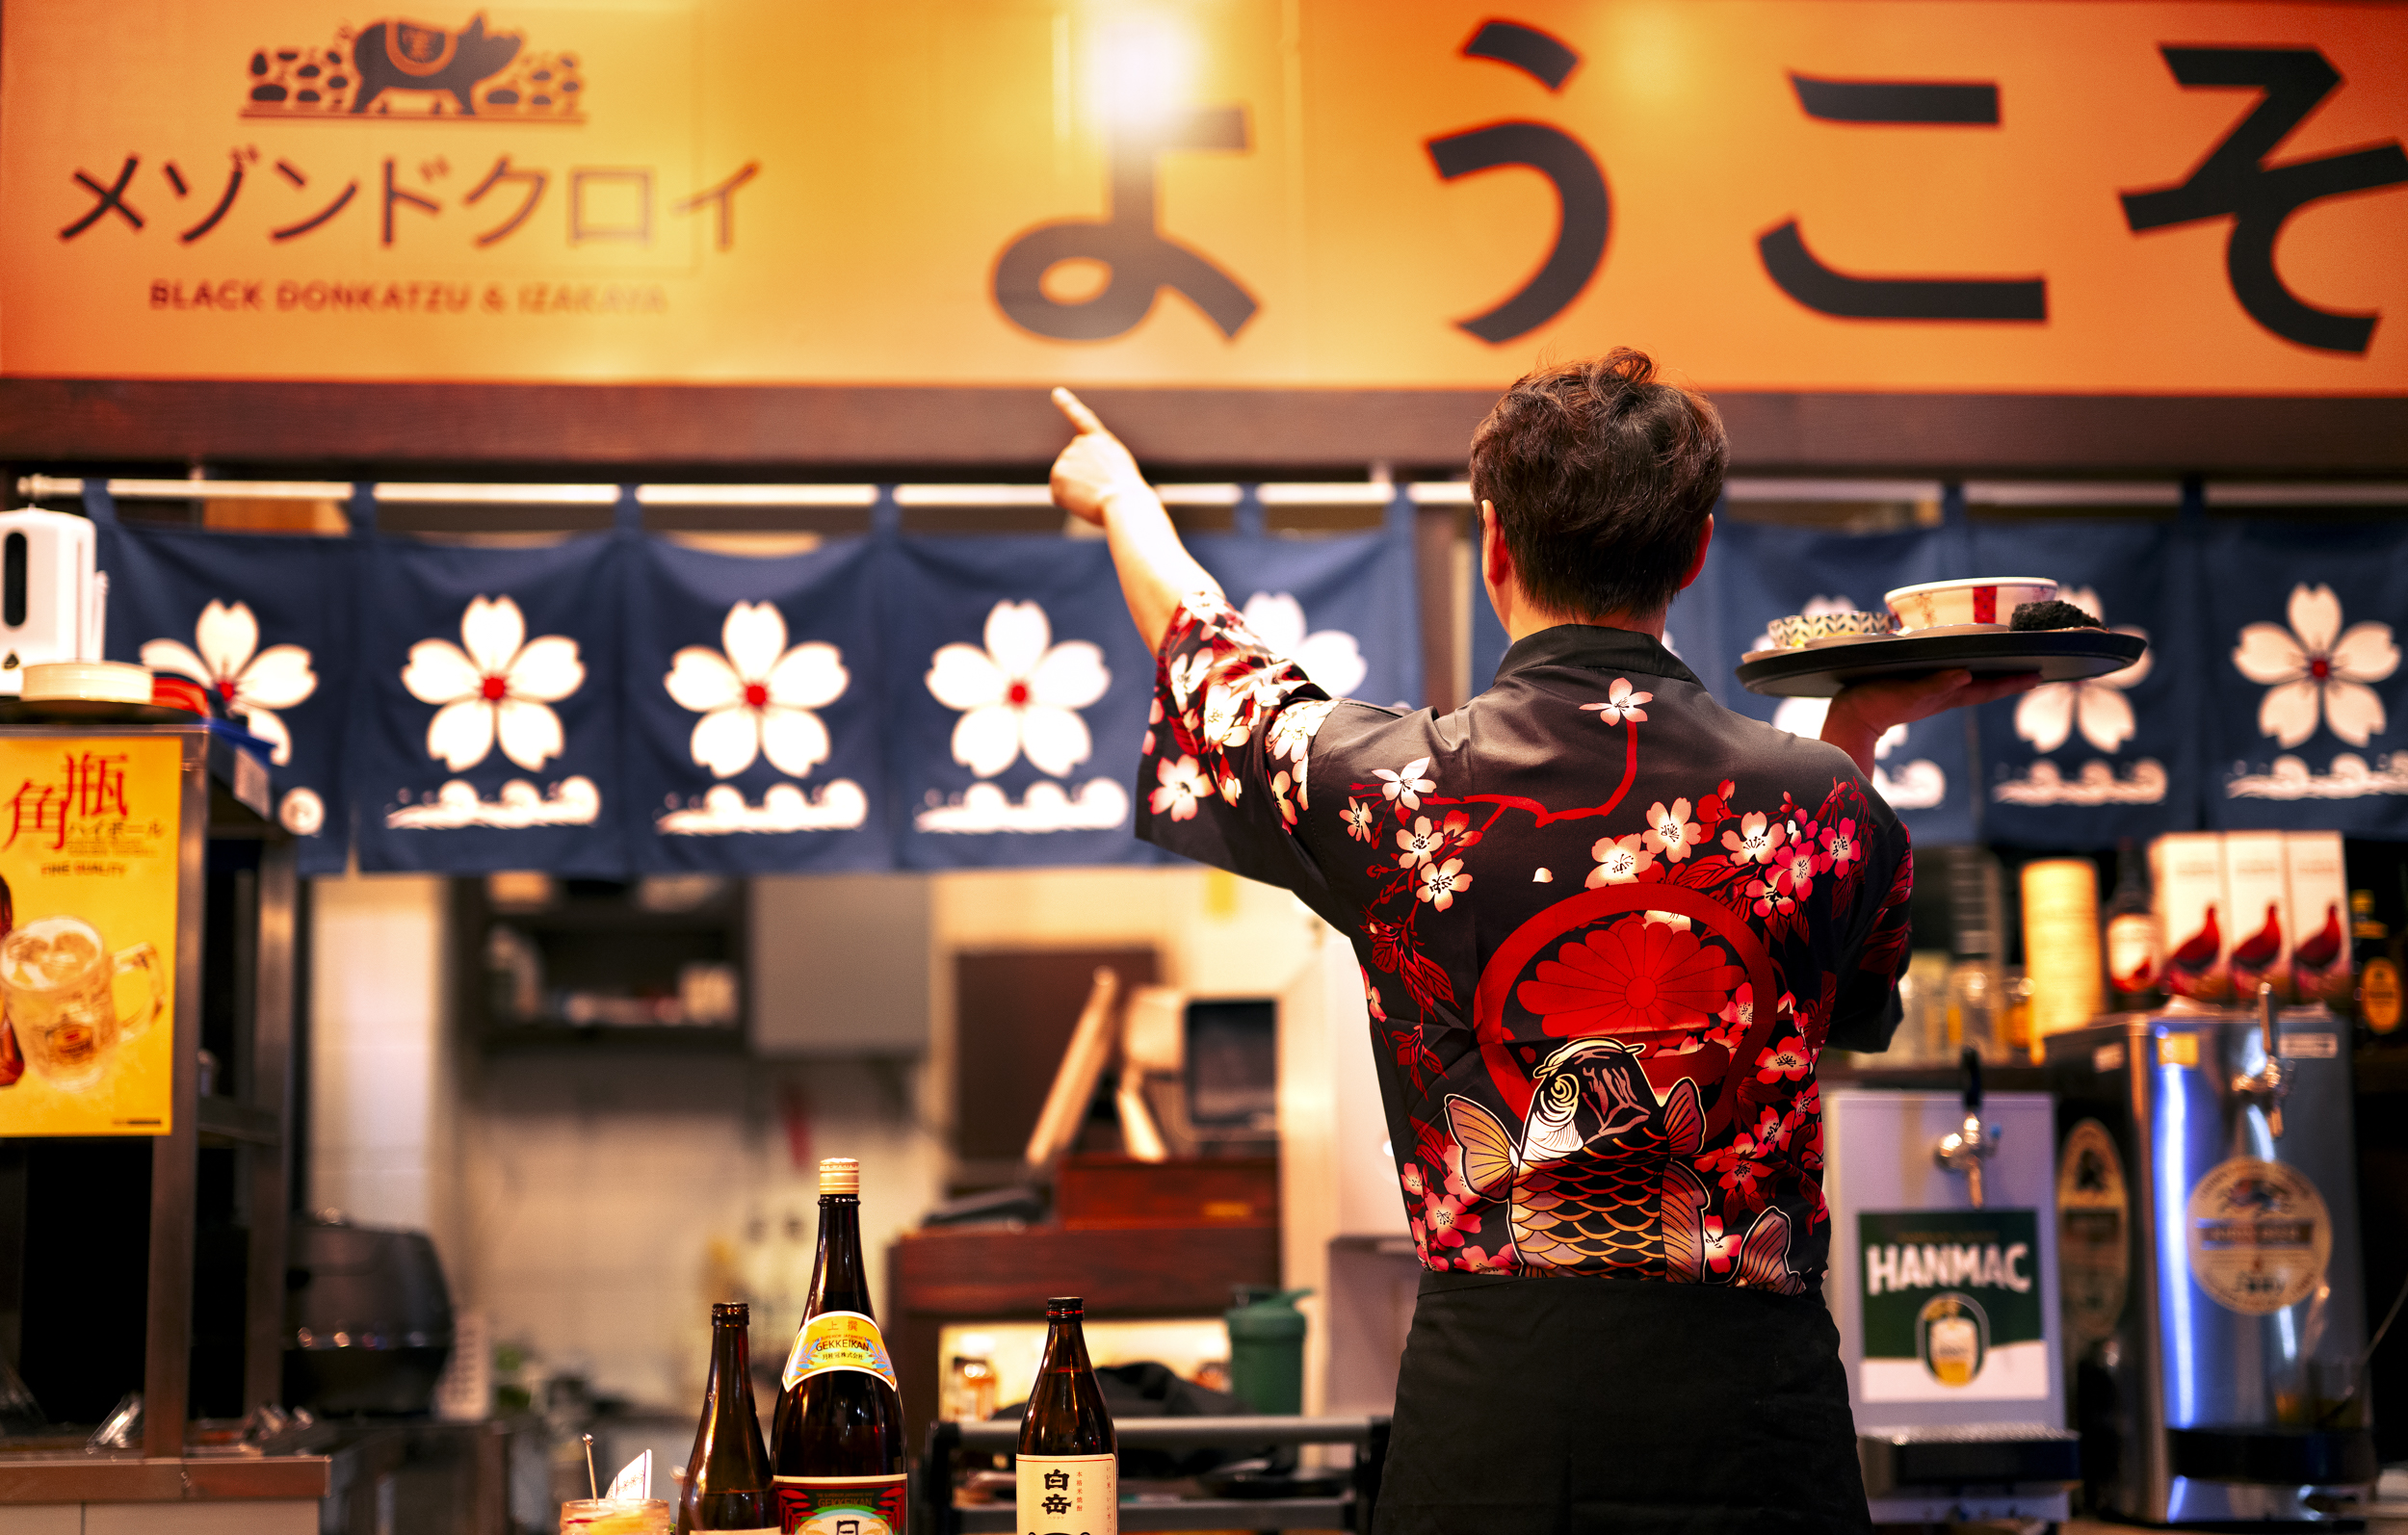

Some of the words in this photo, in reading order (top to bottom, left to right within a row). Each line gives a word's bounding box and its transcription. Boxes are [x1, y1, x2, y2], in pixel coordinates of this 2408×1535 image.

[58, 146, 763, 252] メゾンドクロイ
[988, 16, 2408, 357] ようこそ
[148, 278, 265, 313] BLACK
[275, 278, 471, 315] DONKATZU
[1866, 1241, 2031, 1296] HANMAC
[816, 1339, 870, 1352] GEKKEIKAN
[818, 1497, 873, 1509] GEKKEIKAN
[1041, 1469, 1073, 1515] 白岳
